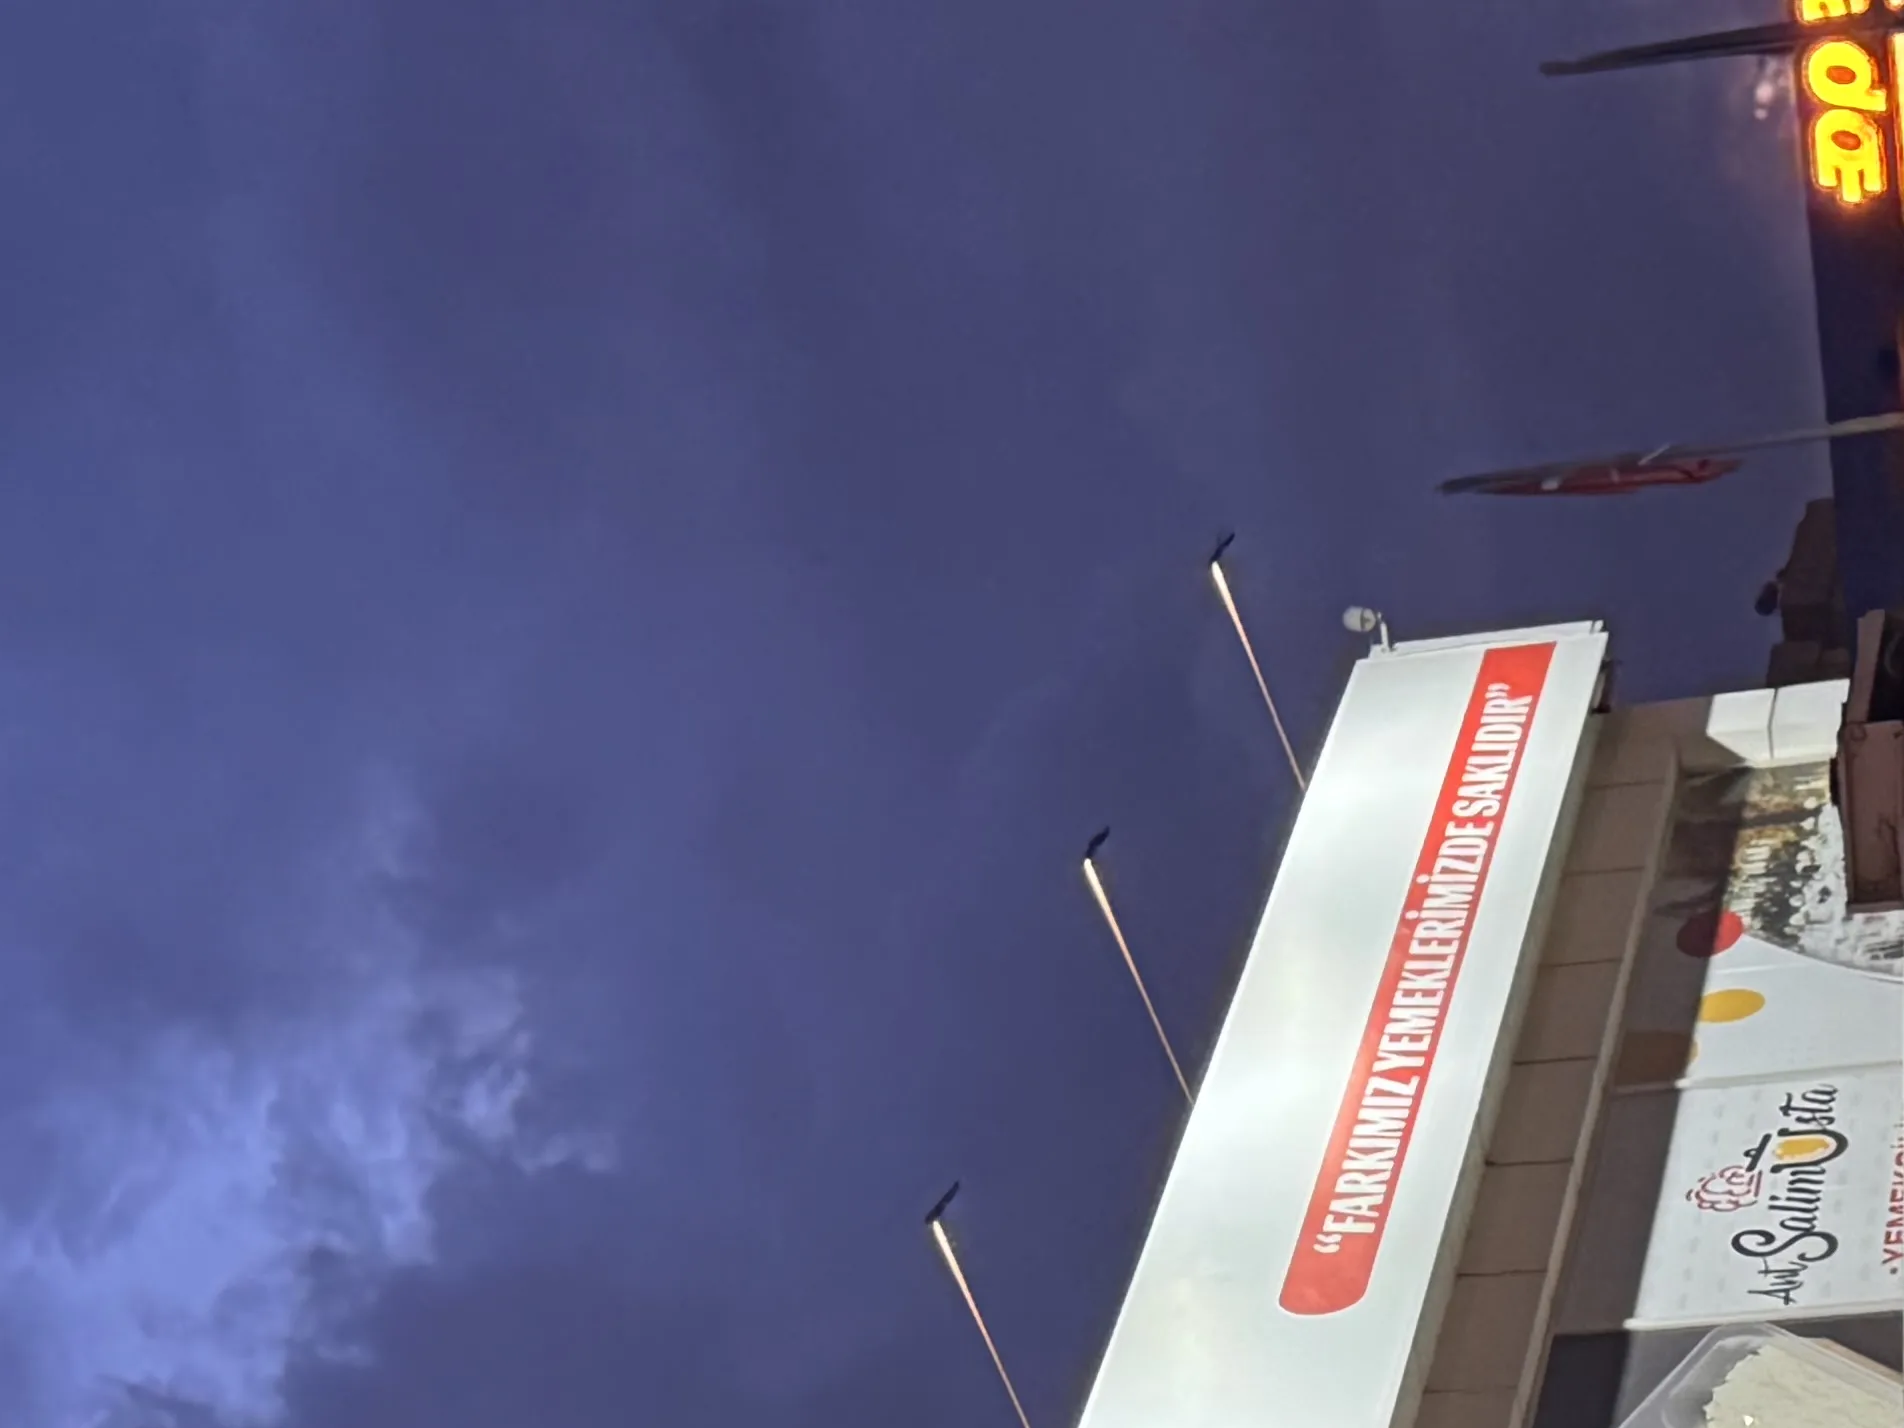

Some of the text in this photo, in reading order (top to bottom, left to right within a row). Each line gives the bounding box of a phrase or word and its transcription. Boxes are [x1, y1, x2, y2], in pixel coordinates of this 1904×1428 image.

[1371, 821, 1493, 1072] YEMEKLERİMİZDE
[1731, 1084, 1848, 1306] Ant Salim Usta
